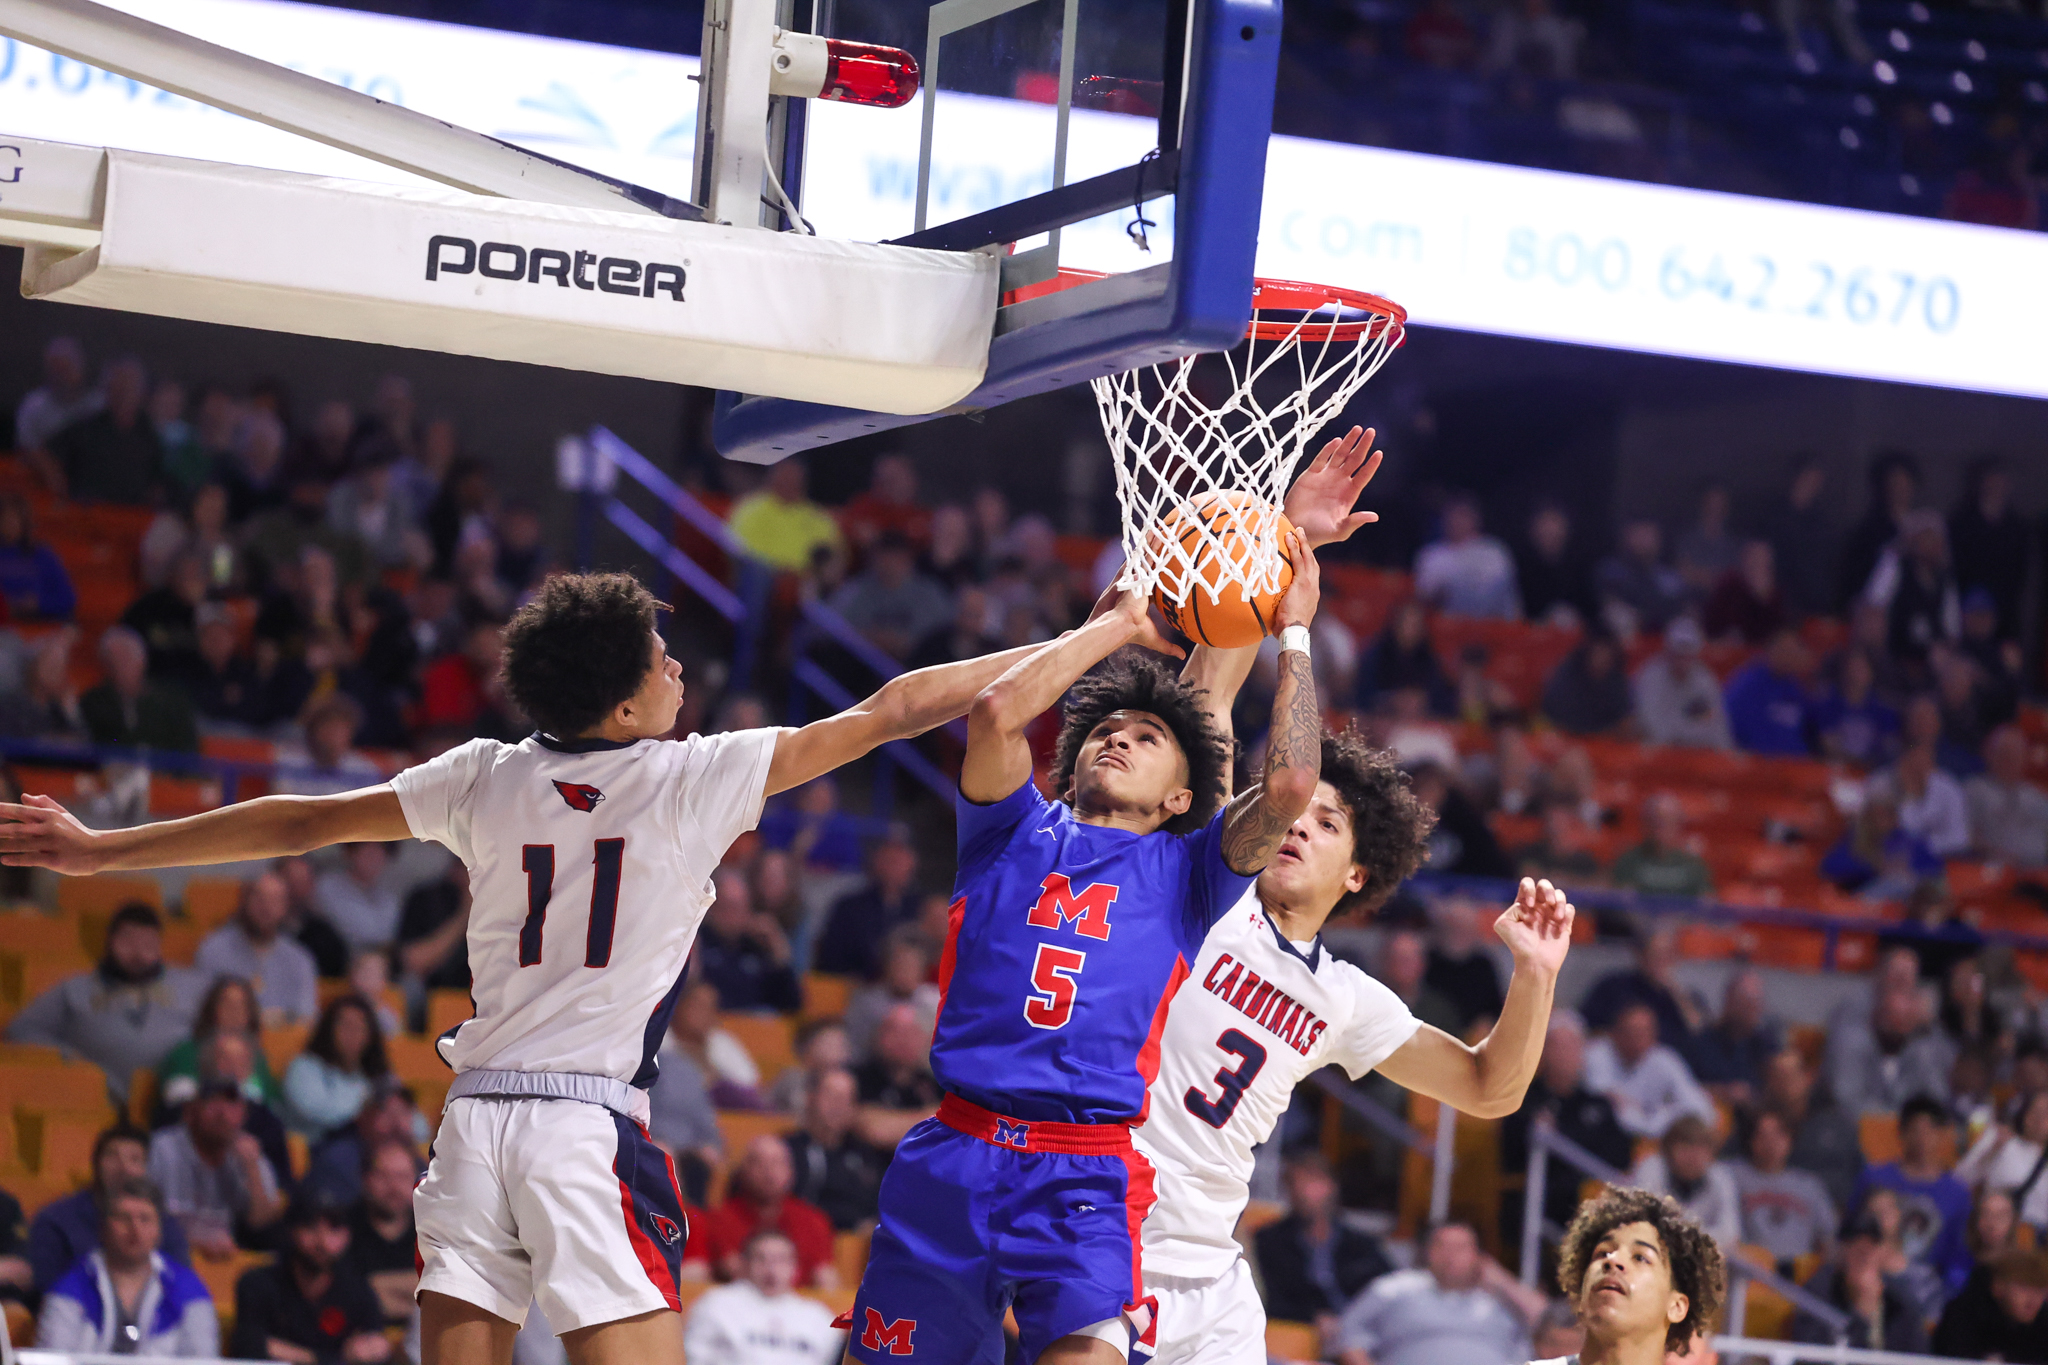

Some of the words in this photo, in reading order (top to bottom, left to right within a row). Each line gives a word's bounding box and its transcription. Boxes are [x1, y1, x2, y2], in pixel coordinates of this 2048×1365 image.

[519, 837, 625, 968] 11
[1026, 872, 1120, 941] M
[1023, 942, 1086, 1030] 5
[1203, 953, 1328, 1056] CARDINALS
[1184, 1028, 1267, 1129] 3
[993, 1117, 1030, 1147] M
[861, 1306, 917, 1355] M
